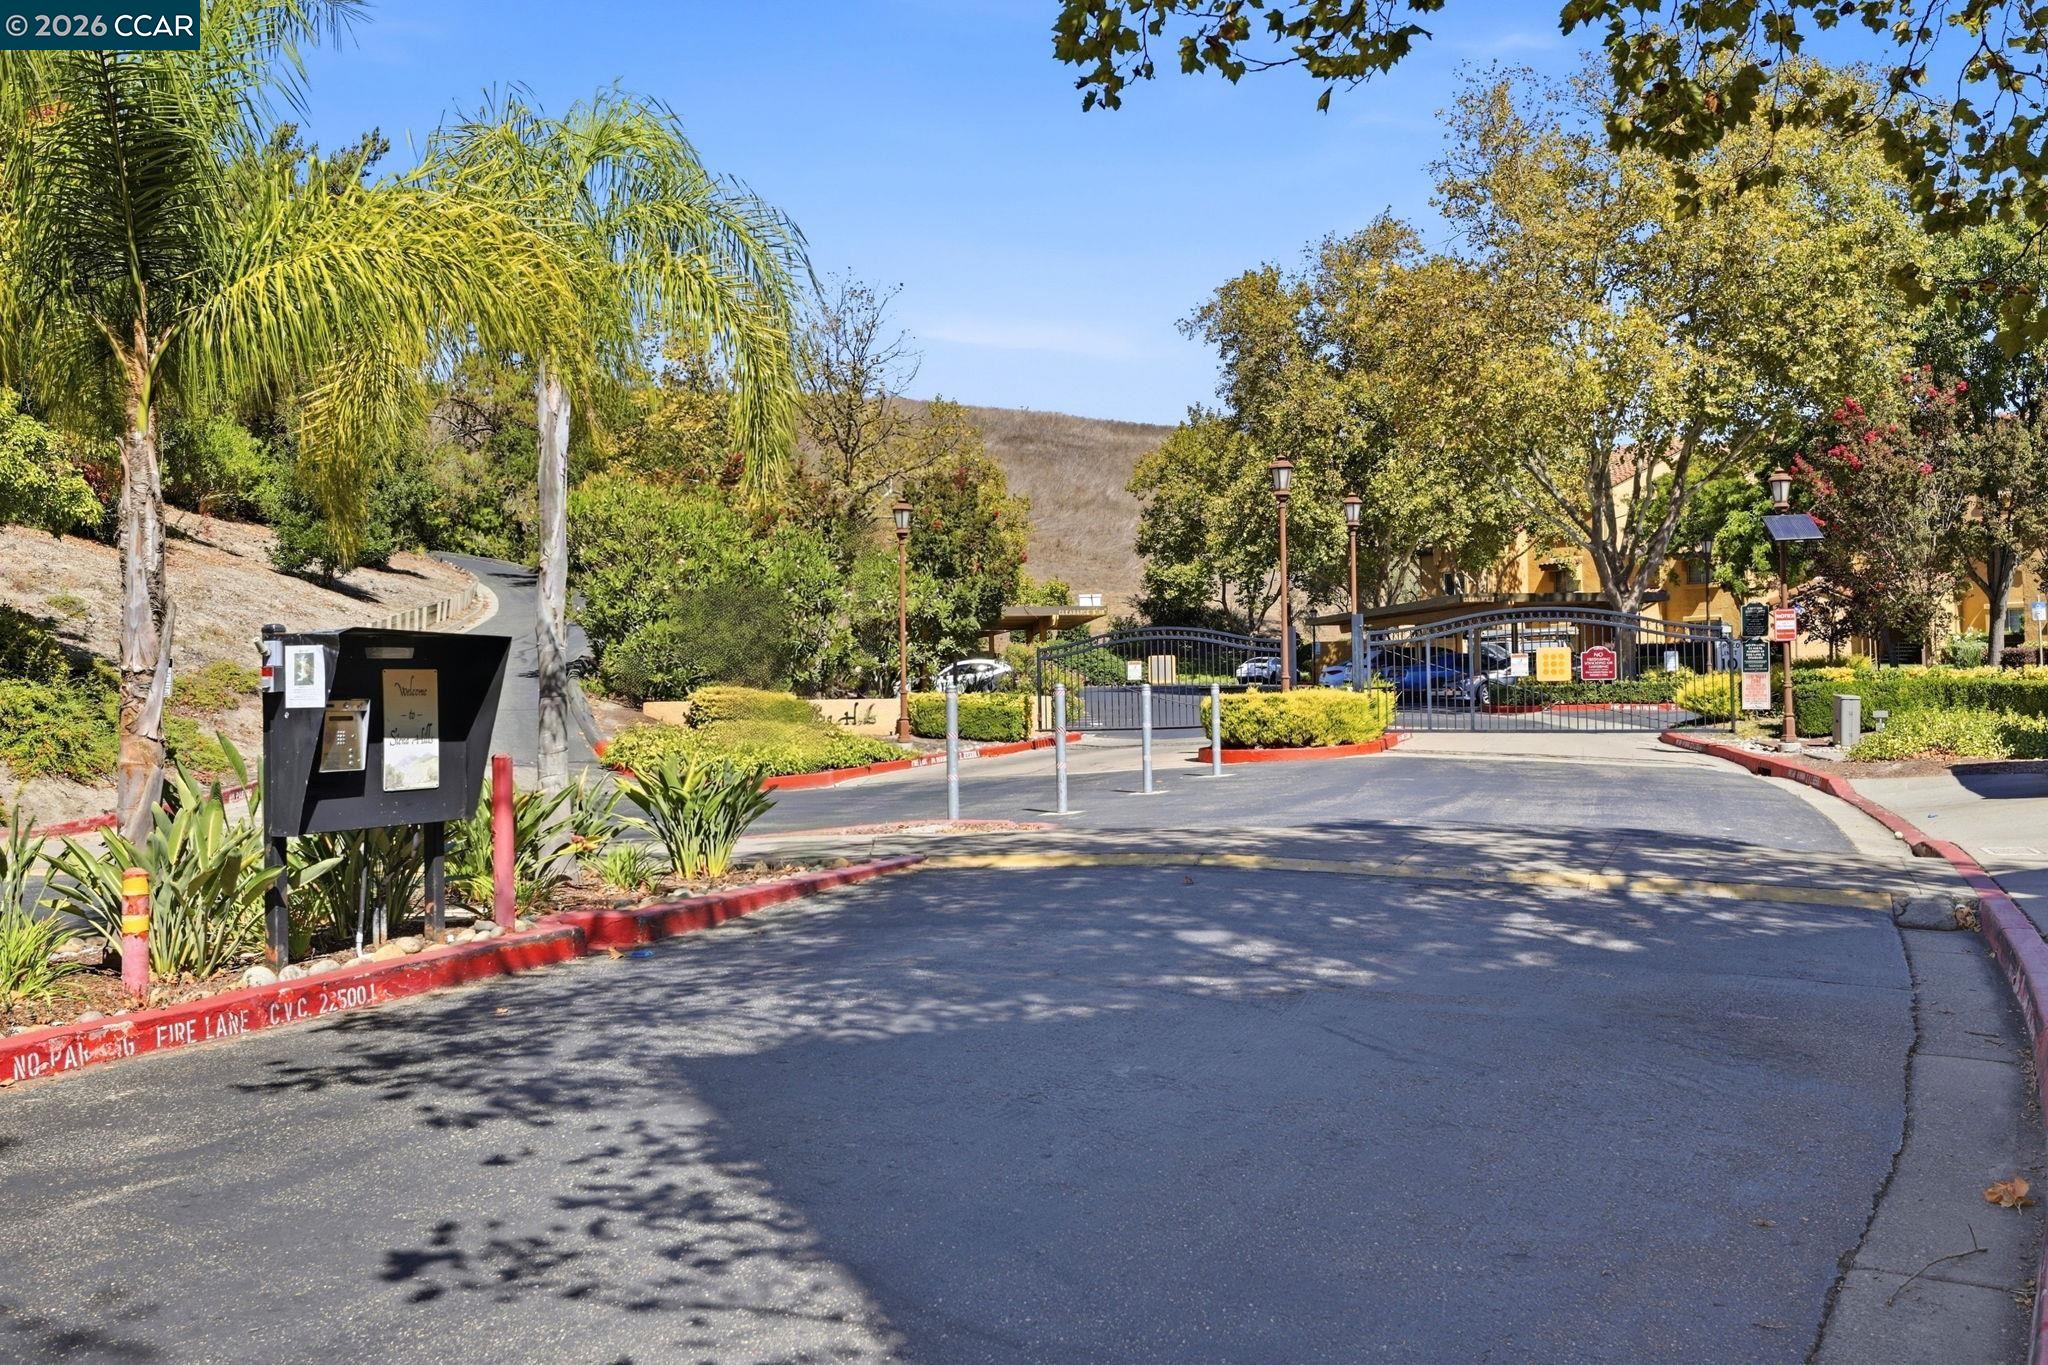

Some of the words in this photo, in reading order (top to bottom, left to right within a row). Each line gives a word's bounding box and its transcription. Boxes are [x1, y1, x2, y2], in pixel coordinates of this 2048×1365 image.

[394, 675, 428, 696] Welcome
[13, 1052, 40, 1081] NO
[156, 1018, 198, 1048] FIRE
[205, 1009, 251, 1040] LANE
